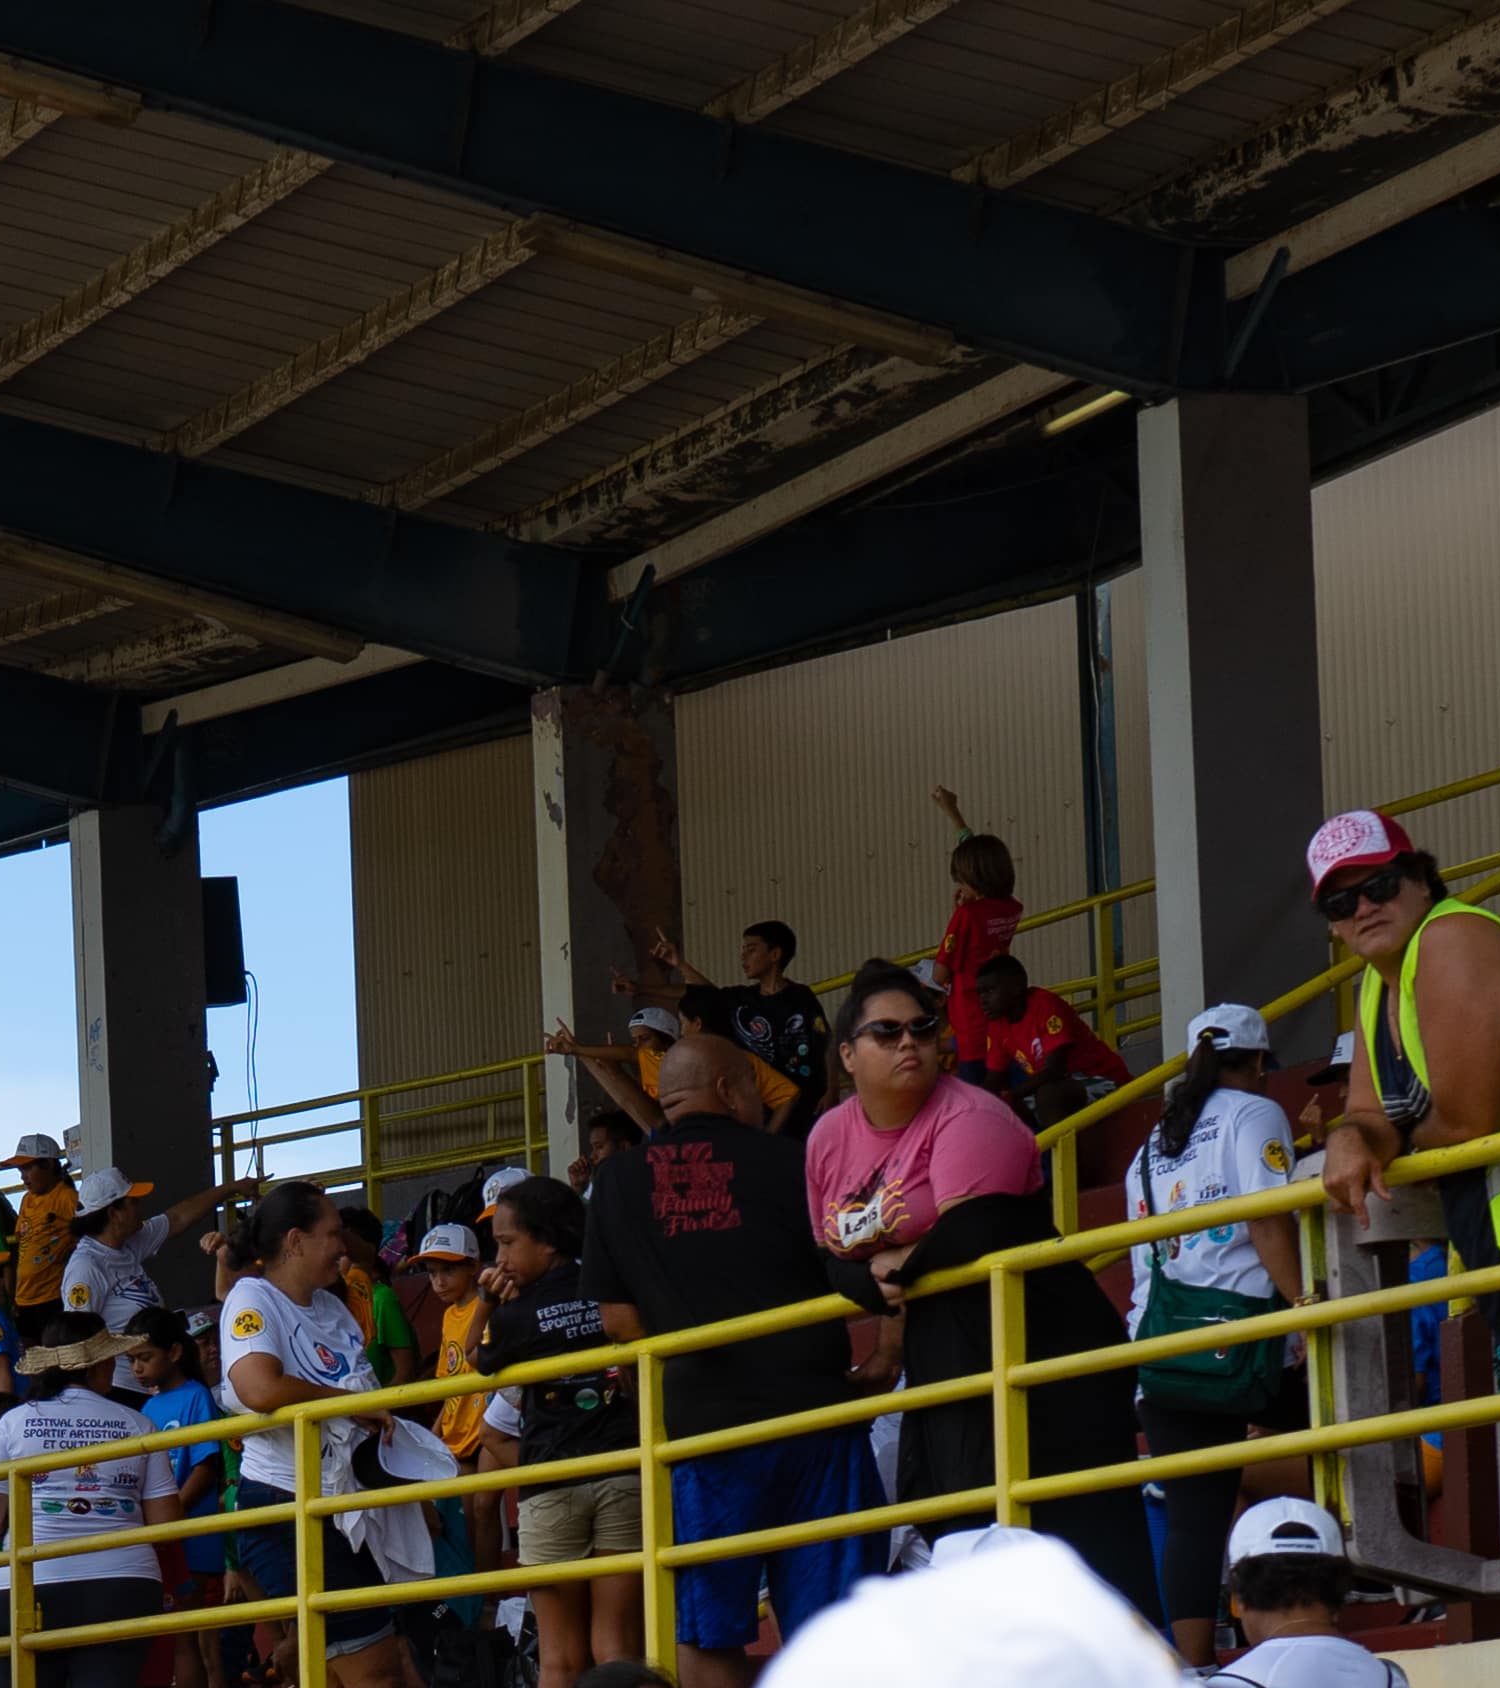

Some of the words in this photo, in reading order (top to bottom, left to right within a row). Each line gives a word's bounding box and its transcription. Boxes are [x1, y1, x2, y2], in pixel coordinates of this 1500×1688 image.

[536, 1300, 587, 1320] FESTIVAL
[539, 1312, 583, 1333] SPORTIF
[566, 1327, 578, 1339] ET
[24, 1418, 74, 1428] FESTIVAL
[75, 1418, 127, 1430] SCOLAIRE
[23, 1428, 66, 1438] SPORTIF
[43, 1440, 56, 1449] ET
[59, 1440, 105, 1450] CULTU
